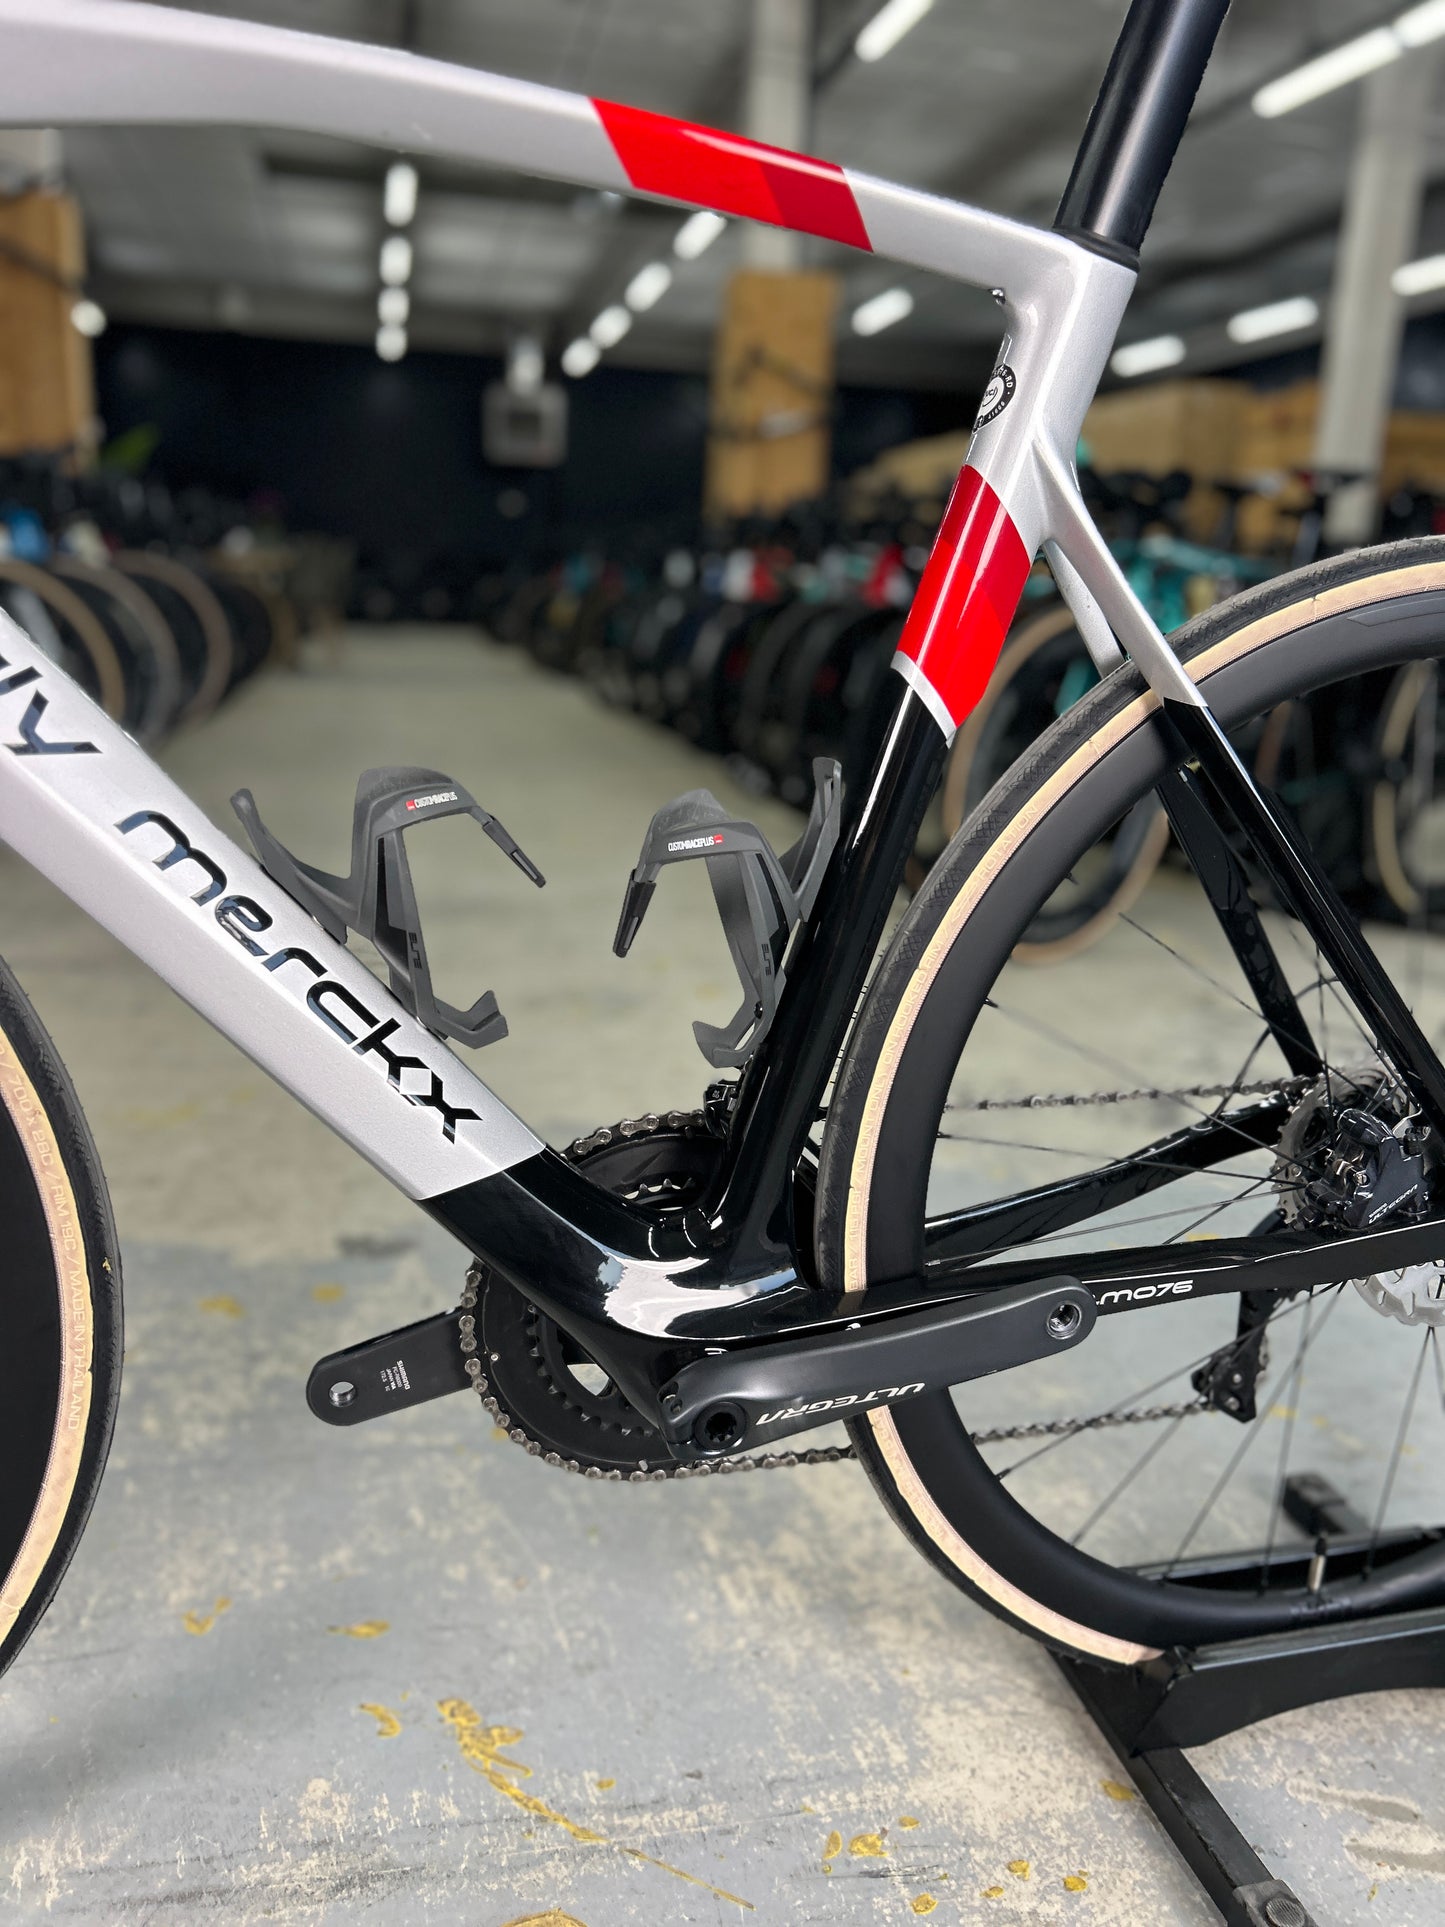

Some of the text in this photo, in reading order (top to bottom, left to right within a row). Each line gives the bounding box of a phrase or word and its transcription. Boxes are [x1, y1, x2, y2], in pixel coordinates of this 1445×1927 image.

[113, 809, 482, 1144] merckx
[51, 1184, 69, 1217] RIM
[59, 1221, 77, 1251] 19C
[69, 1270, 86, 1322] MADE
[73, 1325, 86, 1341] IN
[67, 1346, 86, 1430] THAILAND
[755, 1382, 926, 1425] ULTEGRA
